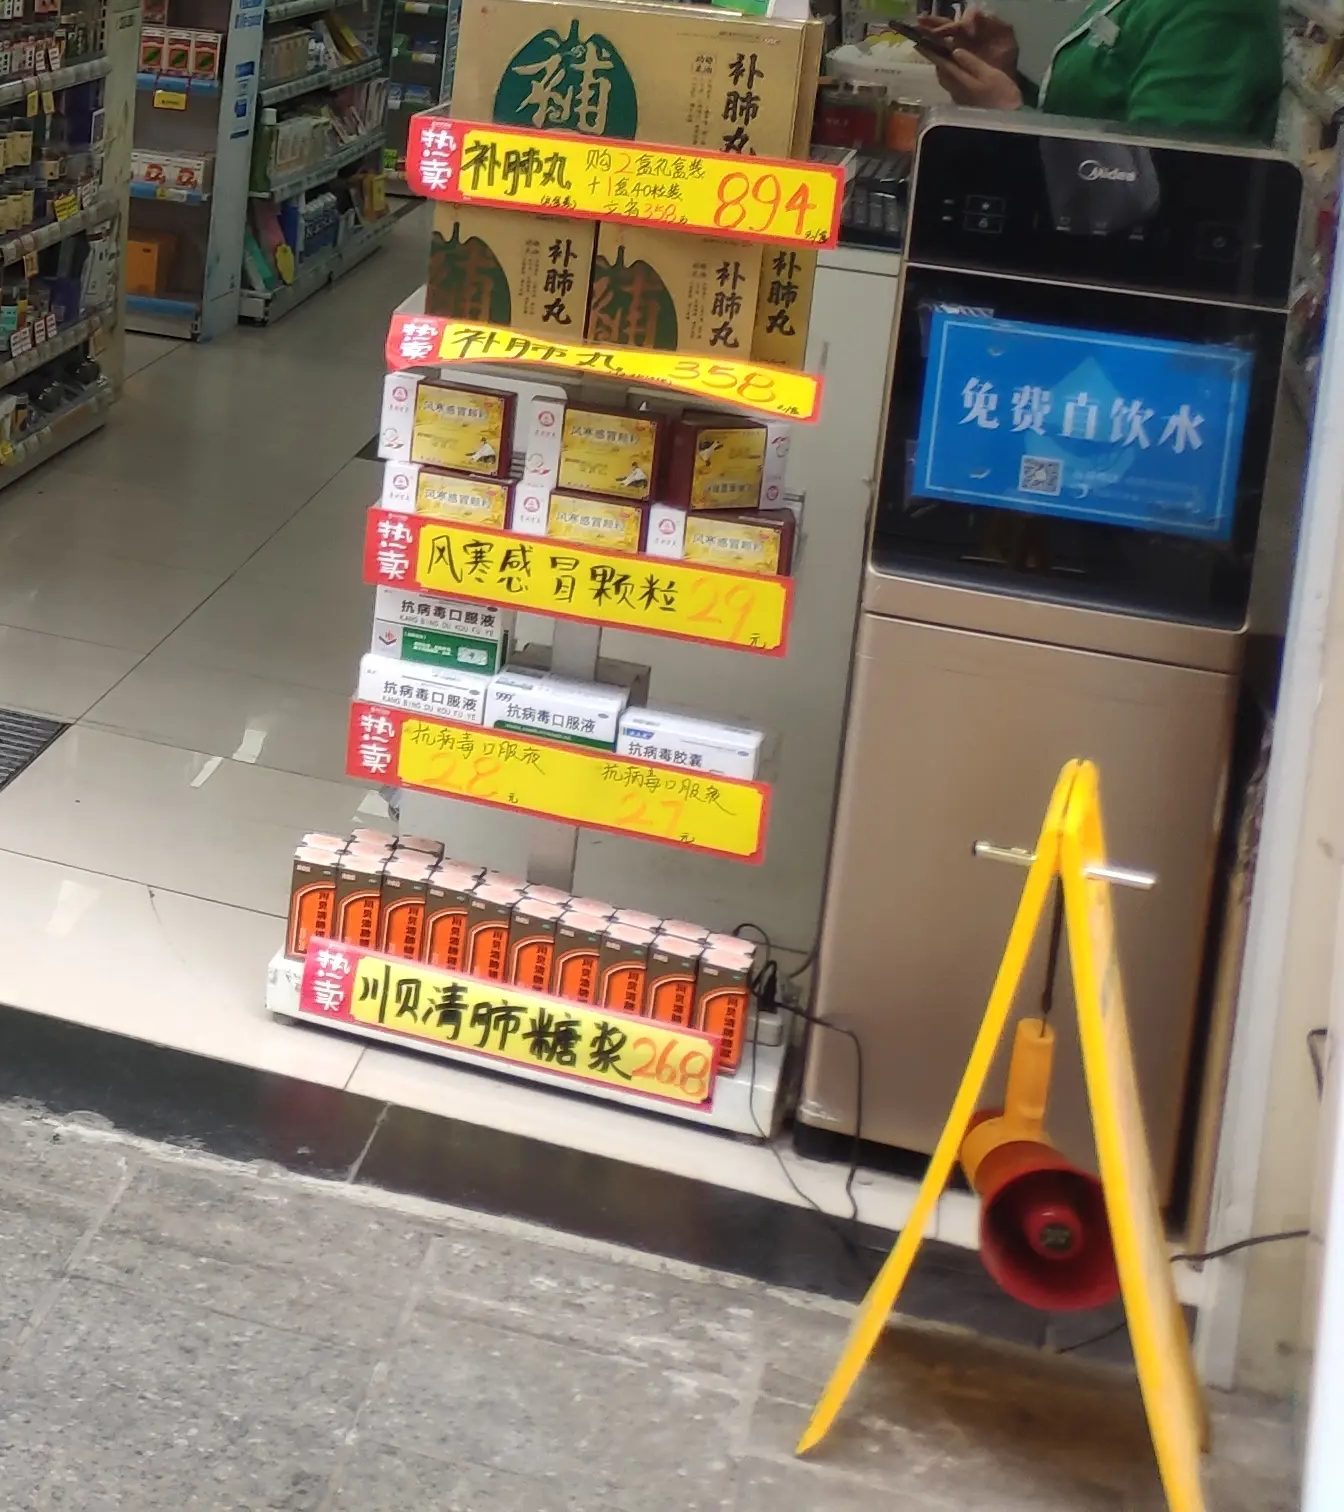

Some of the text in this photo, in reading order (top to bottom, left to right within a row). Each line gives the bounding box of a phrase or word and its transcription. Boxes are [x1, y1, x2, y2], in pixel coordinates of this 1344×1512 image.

[719, 52, 765, 158] 补肺丸
[418, 127, 457, 191] 热卖
[461, 138, 573, 197] 补肺丸
[712, 169, 817, 237] 894
[541, 237, 578, 326] 补肺丸
[708, 260, 746, 350] 补肺丸
[765, 250, 802, 337] 补肺丸
[399, 321, 439, 361] 热卖
[447, 326, 624, 373] 补肺丸
[667, 359, 777, 407] 358
[570, 423, 641, 447] 风寒感冒颗粒
[957, 376, 1206, 455] 免费直饮水
[376, 521, 414, 581] 热卖
[555, 510, 626, 534] 风寒感冒颗粒
[691, 531, 765, 552] 风寒感冒颗粒
[428, 534, 679, 613] 风寒感冒颗粒
[400, 599, 496, 629] 抗病毒口服液
[688, 576, 756, 643] 29
[383, 680, 478, 712] 抗病毒口服液
[506, 702, 596, 735] 抗病毒口服液
[358, 714, 396, 774] 热卖
[412, 724, 547, 776] 抗病毒口服液
[627, 741, 704, 768] 抗病毒胶囊
[422, 751, 501, 801] 28
[601, 763, 737, 816] 抗病毒口服液
[617, 790, 685, 832] 27
[314, 948, 351, 1013] 热卖
[358, 964, 633, 1081] 川贝清肺糖浆
[631, 1036, 712, 1100] 268
